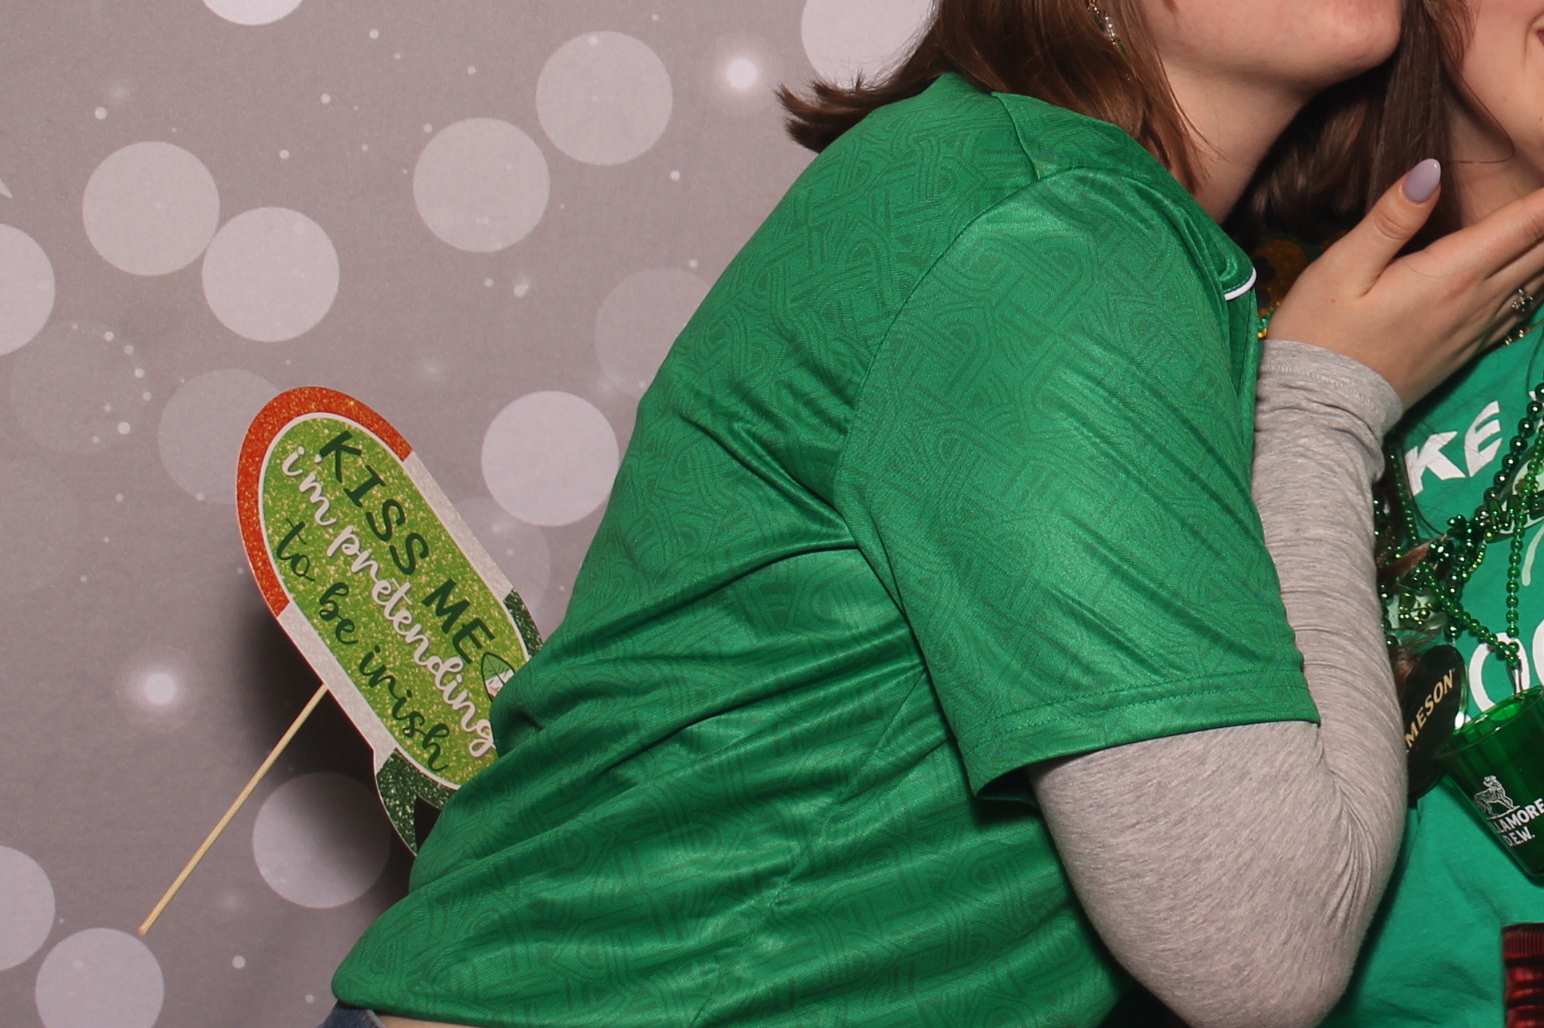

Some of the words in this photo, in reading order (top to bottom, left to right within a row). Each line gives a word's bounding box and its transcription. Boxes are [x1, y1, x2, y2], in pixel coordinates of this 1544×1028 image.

[318, 429, 431, 578] KISS
[421, 577, 496, 665] ME
[1404, 399, 1503, 498] KE
[276, 517, 316, 582] to
[318, 581, 359, 645] be
[358, 644, 450, 772] irish
[326, 524, 497, 758] pretending
[1404, 668, 1454, 752] MESON
